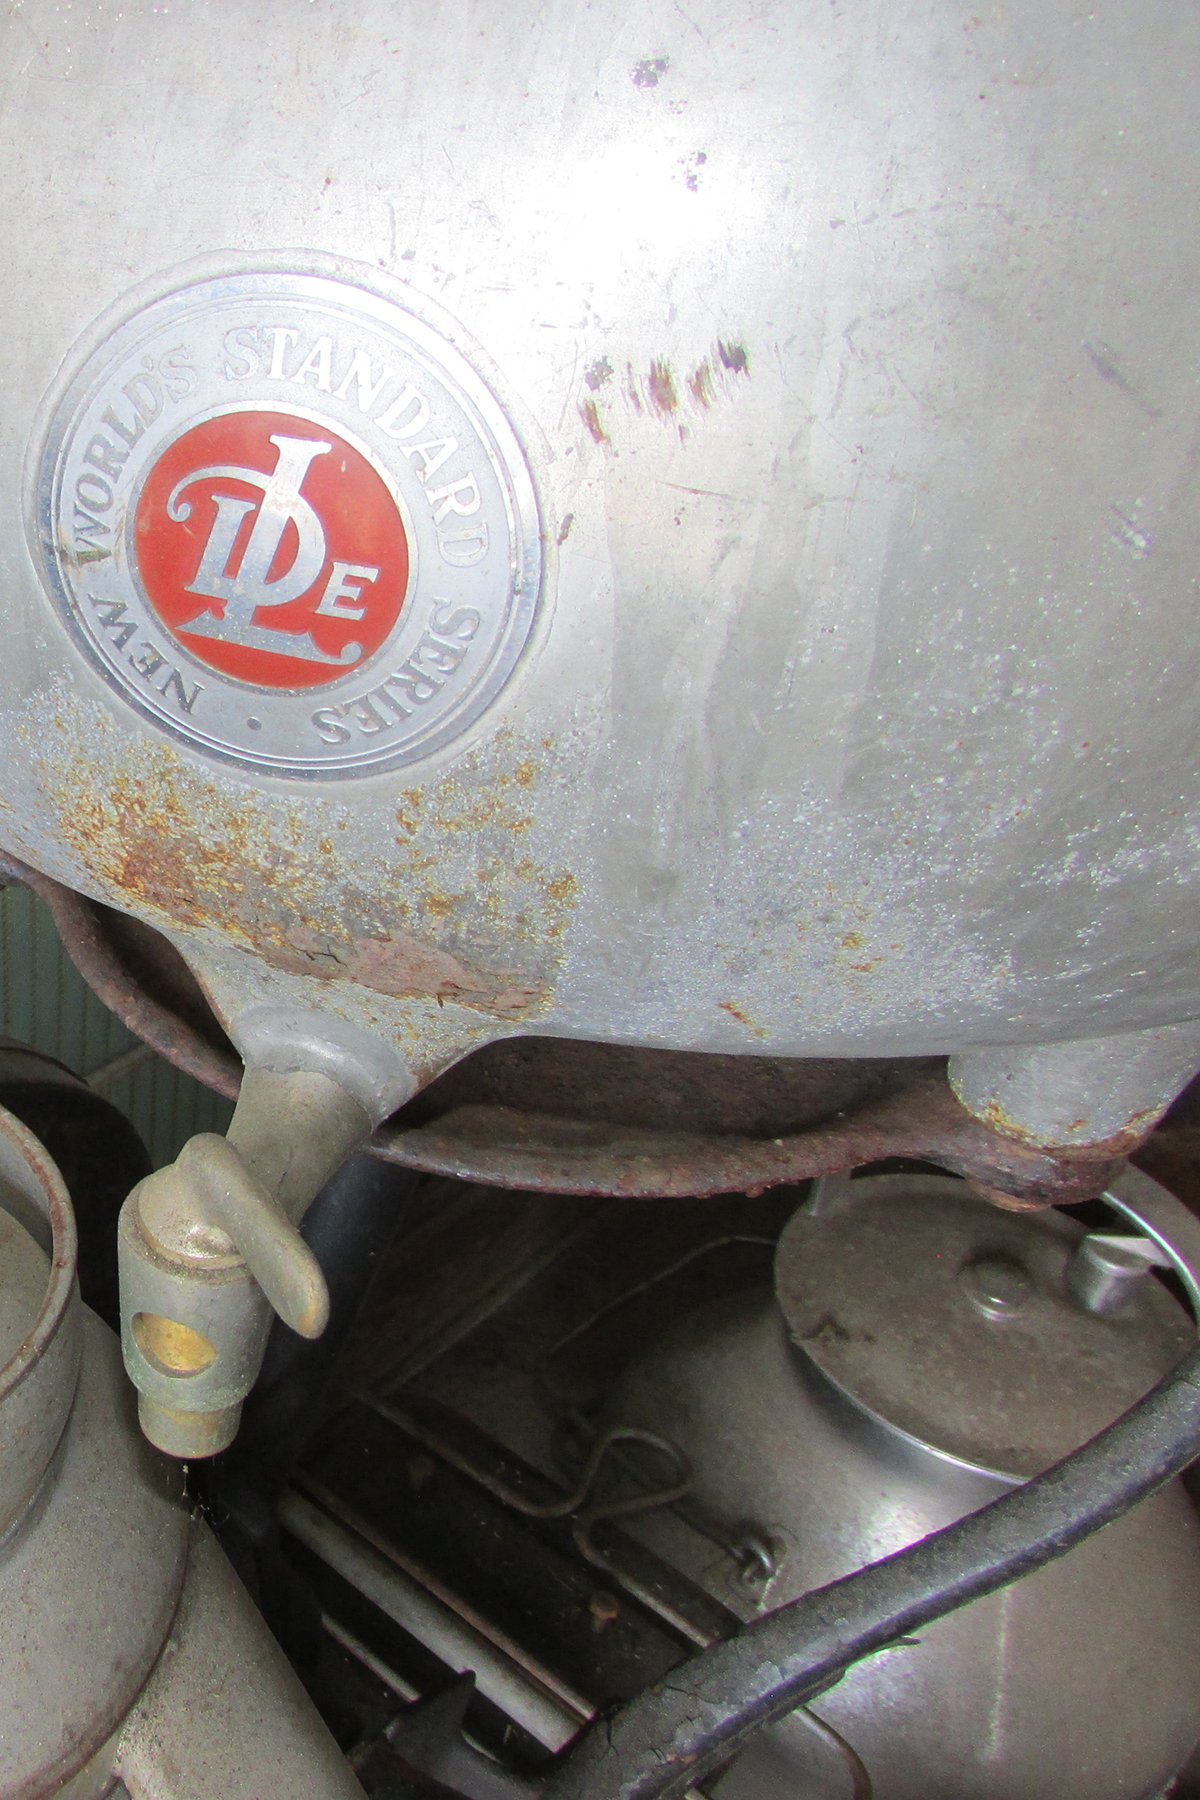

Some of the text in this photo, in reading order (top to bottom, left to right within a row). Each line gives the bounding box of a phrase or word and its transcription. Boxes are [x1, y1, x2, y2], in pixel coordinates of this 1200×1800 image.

[74, 325, 491, 745] NEW WORLD'S STANDARD SERIES
